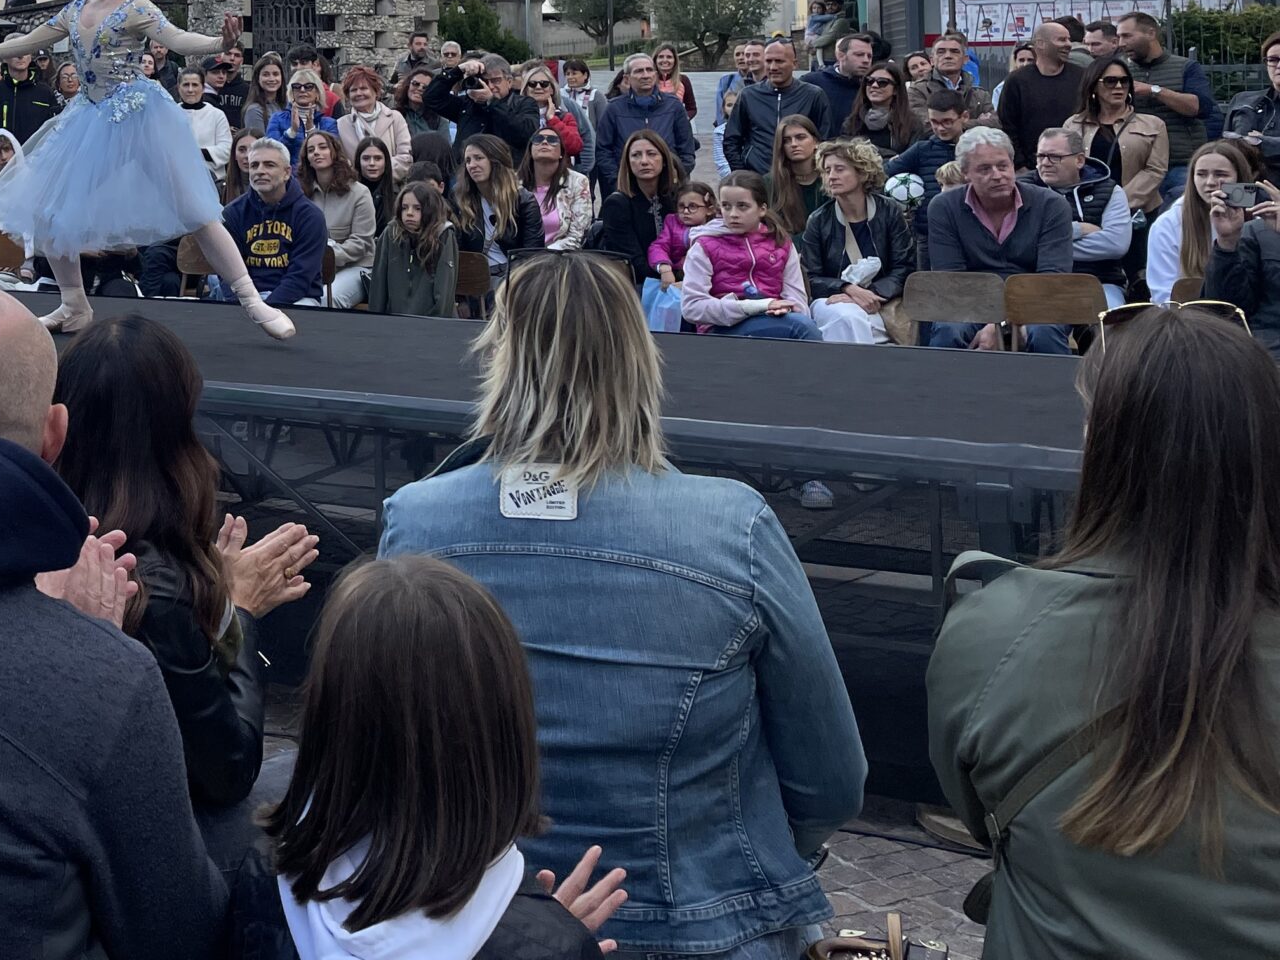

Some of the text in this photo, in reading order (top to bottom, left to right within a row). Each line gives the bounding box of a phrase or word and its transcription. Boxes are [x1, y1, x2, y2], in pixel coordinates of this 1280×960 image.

[265, 220, 293, 242] YORK
[264, 253, 289, 267] YORK
[523, 471, 550, 481] D&G
[508, 480, 568, 508] VINTAGE
